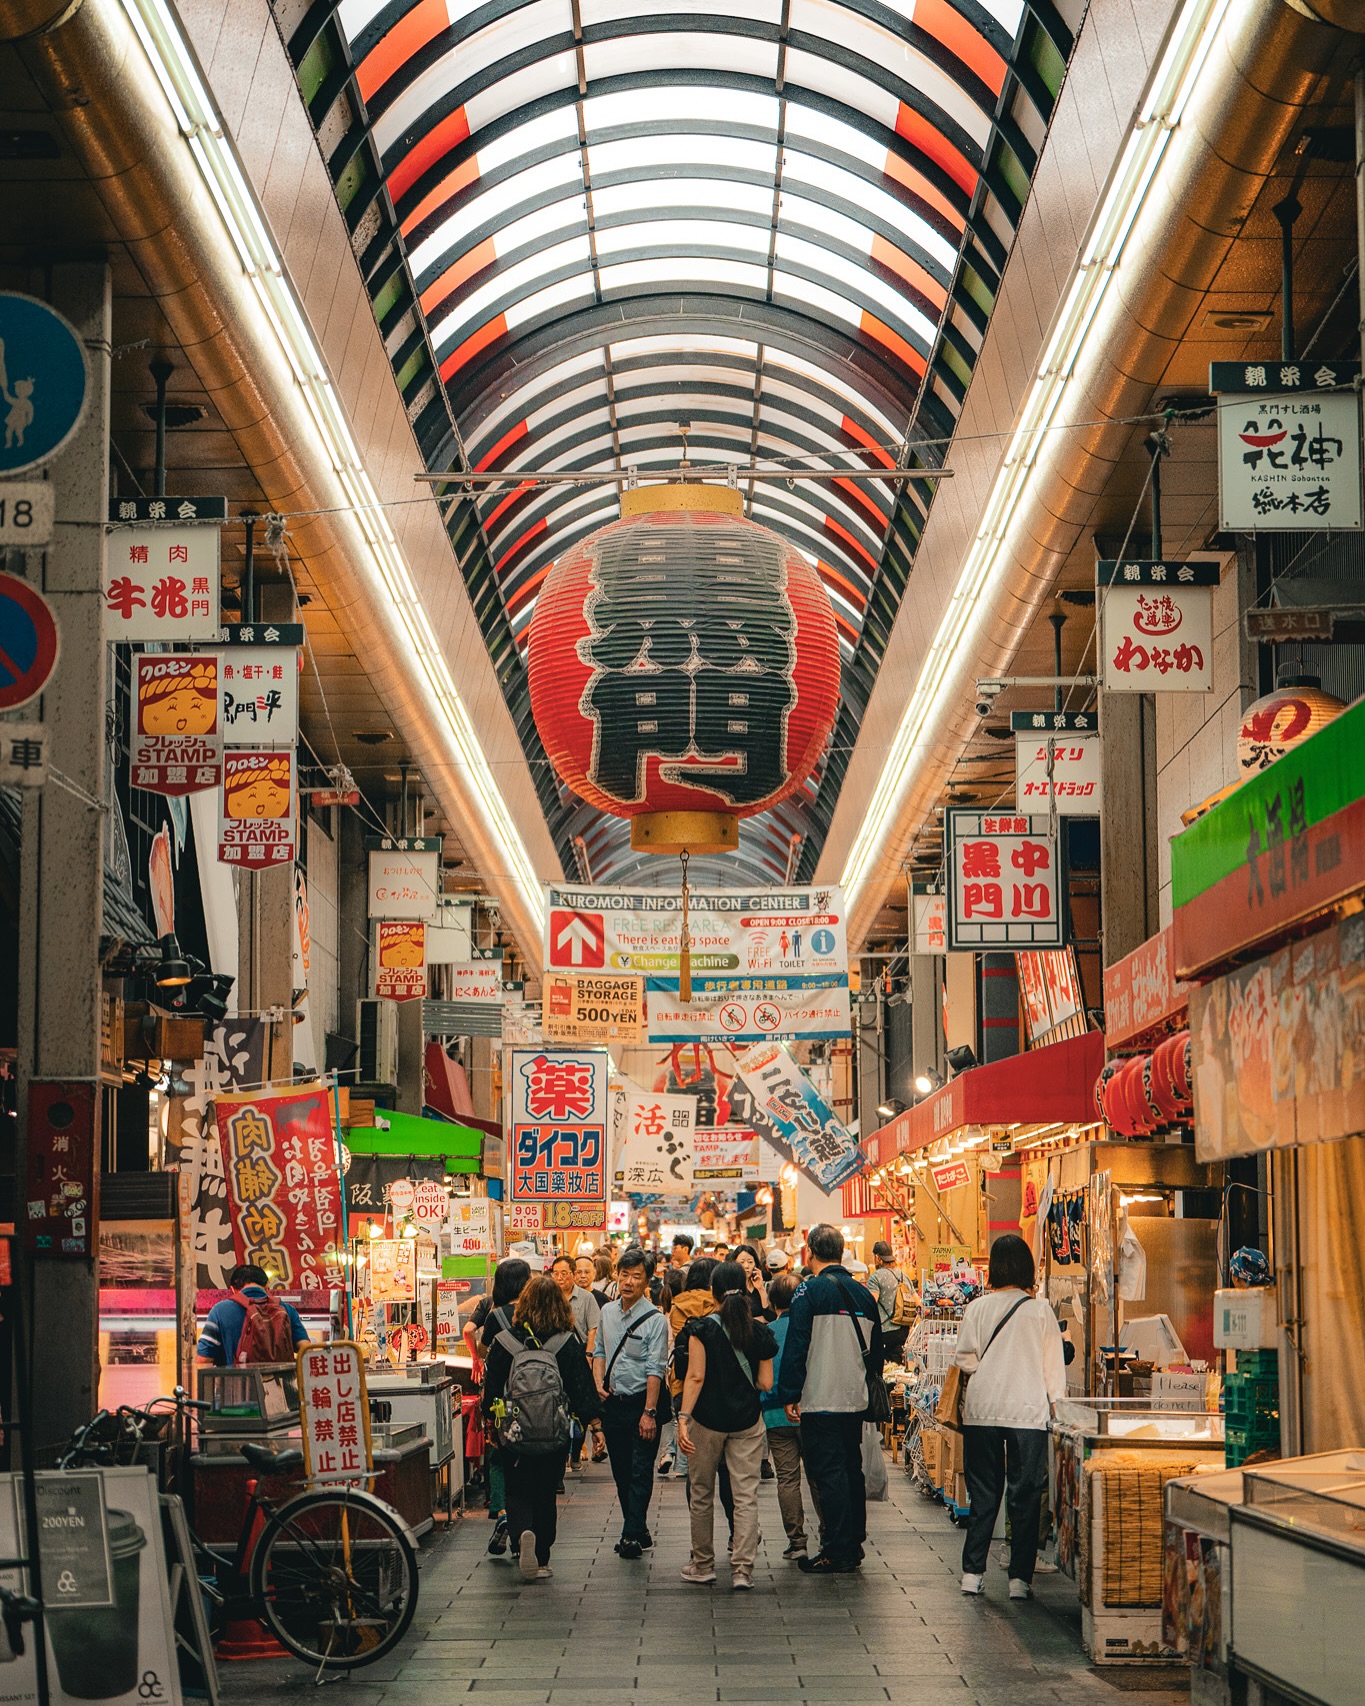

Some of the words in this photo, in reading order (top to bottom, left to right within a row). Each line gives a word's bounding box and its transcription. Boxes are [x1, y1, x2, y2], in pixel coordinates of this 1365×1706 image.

[1245, 366, 1337, 386] 親栄会
[1258, 404, 1321, 415] 黒門すし酒場
[1252, 485, 1332, 516] 総本店
[129, 544, 189, 564] 精肉
[191, 577, 210, 617] 黒門
[1113, 636, 1204, 674] わなか
[141, 660, 191, 680] クロモン
[144, 736, 207, 748] フレッシュ
[138, 749, 216, 763] STAMP
[226, 757, 269, 771] クロモン
[138, 768, 216, 784] 加盟店
[1024, 782, 1097, 796] オーエスドラッグ
[229, 819, 281, 830] フレッシュ
[223, 829, 290, 842] STAMP
[224, 845, 289, 860] 加盟店
[962, 841, 1003, 918] 黒門
[1011, 840, 1050, 918] 中川
[558, 893, 634, 909] KUROMON
[642, 895, 742, 911] INFORMATION
[749, 896, 800, 909] CENTER
[613, 918, 648, 932] FREE
[691, 919, 732, 932] AREA
[750, 918, 769, 926] OPEN
[771, 918, 786, 926] 9:00
[788, 917, 810, 925] CLOSE
[811, 917, 829, 925] 18:00
[381, 925, 410, 937] クロモン
[616, 934, 647, 945] There
[650, 934, 659, 945] is
[699, 935, 730, 948] space
[748, 947, 771, 957] FREE
[633, 955, 677, 970] Change
[690, 955, 729, 967] achine
[748, 959, 772, 969] Wi-Fi
[779, 960, 805, 968] TOILET
[379, 975, 423, 984] STAMP
[577, 980, 637, 990] BAGGAGE
[379, 985, 424, 995] 加盟店
[577, 990, 637, 1001] STORAGE
[577, 1007, 609, 1022] 500
[611, 1013, 637, 1023] YEN
[656, 1013, 715, 1022] 自転車走行禁止
[784, 1009, 841, 1018] バイク通行禁止
[525, 1056, 592, 1119] 薬
[634, 1104, 667, 1136] 活
[518, 1129, 601, 1168] ダイコク
[657, 1131, 691, 1180] ふぐ
[701, 1153, 749, 1165] 終了します
[628, 1167, 664, 1183] 深広
[937, 1168, 966, 1184] たばこ
[421, 1183, 437, 1193] eat
[415, 1194, 445, 1203] inside
[417, 1205, 445, 1218] OK!
[515, 1206, 537, 1215] 9:05
[513, 1219, 539, 1227] 21:50
[454, 1226, 486, 1235] 生ビール
[425, 1310, 454, 1321] 生ール
[1160, 1376, 1200, 1391] Please
[309, 1356, 337, 1474] 駐輪禁止
[333, 1352, 360, 1471] 出し店禁止
[37, 1485, 81, 1495] Discount
[43, 1516, 85, 1528] 200YEN
